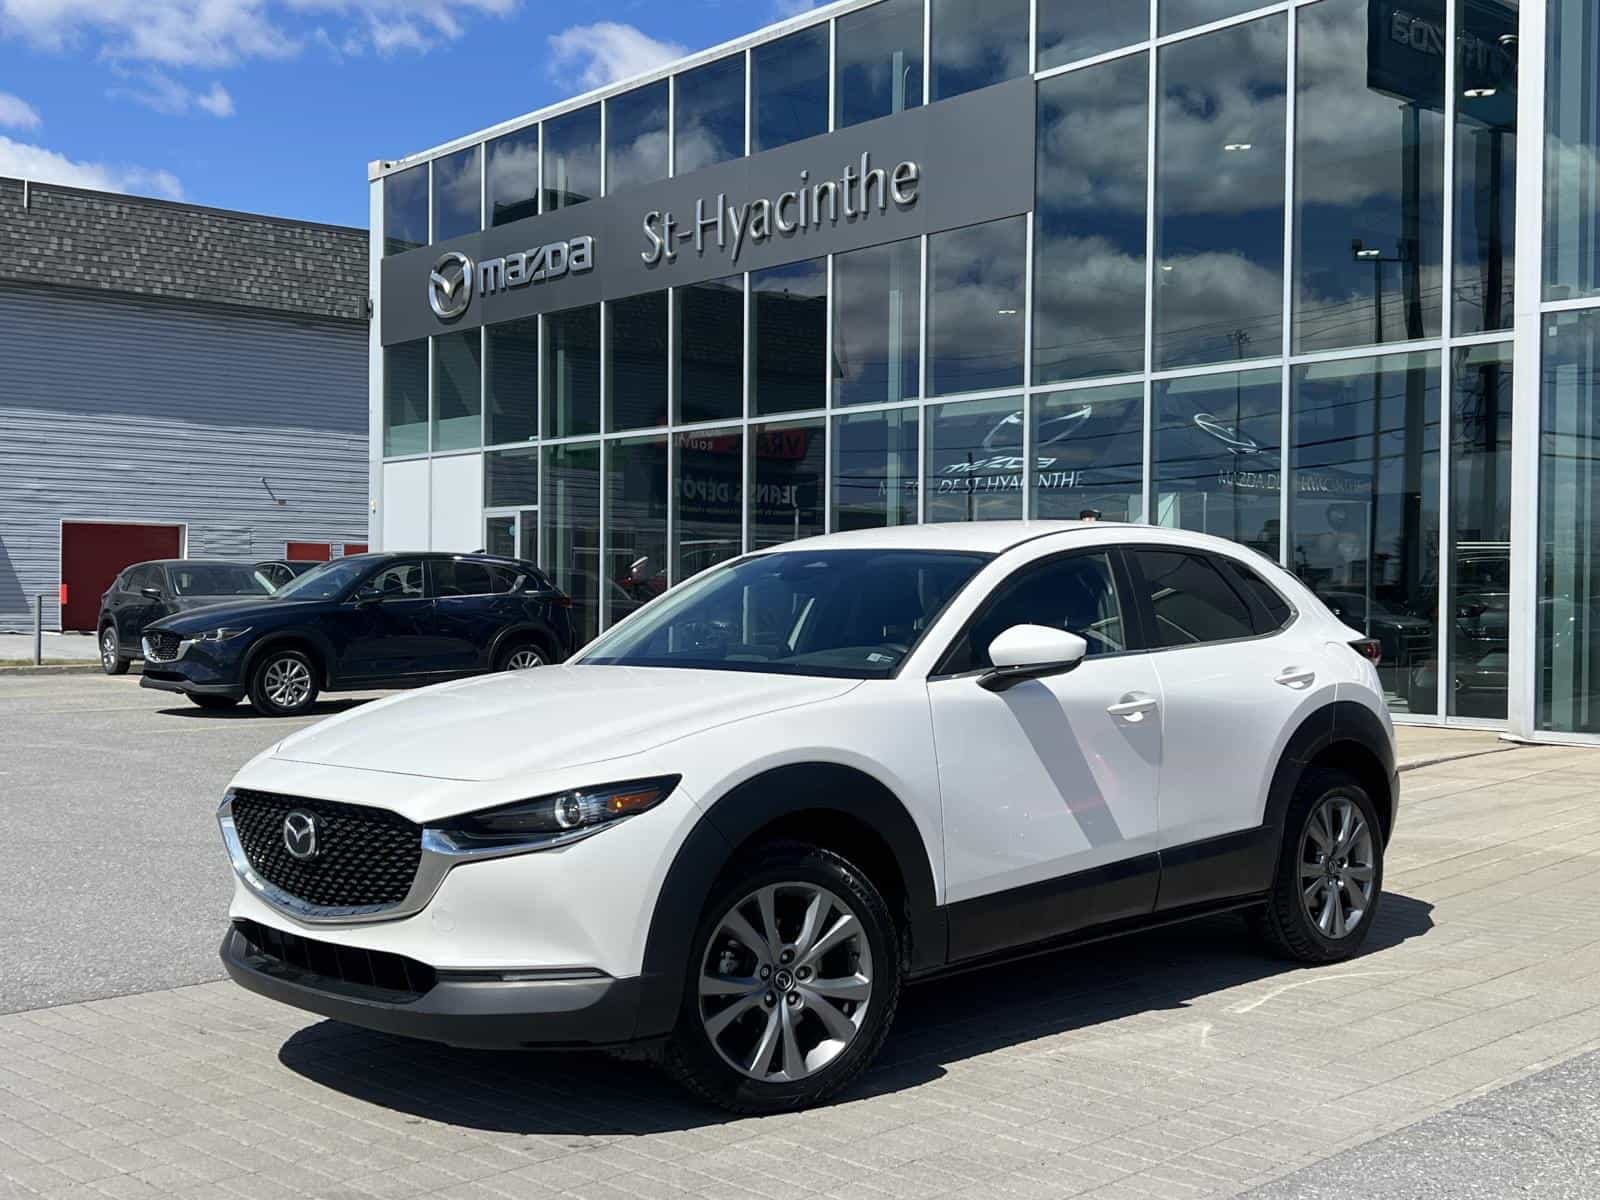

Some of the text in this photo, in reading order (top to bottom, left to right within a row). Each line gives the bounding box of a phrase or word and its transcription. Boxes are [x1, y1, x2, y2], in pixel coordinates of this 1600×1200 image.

[477, 151, 921, 295] mazda St-Hyacinthe
[961, 470, 1085, 495] ST-HYANTHE
